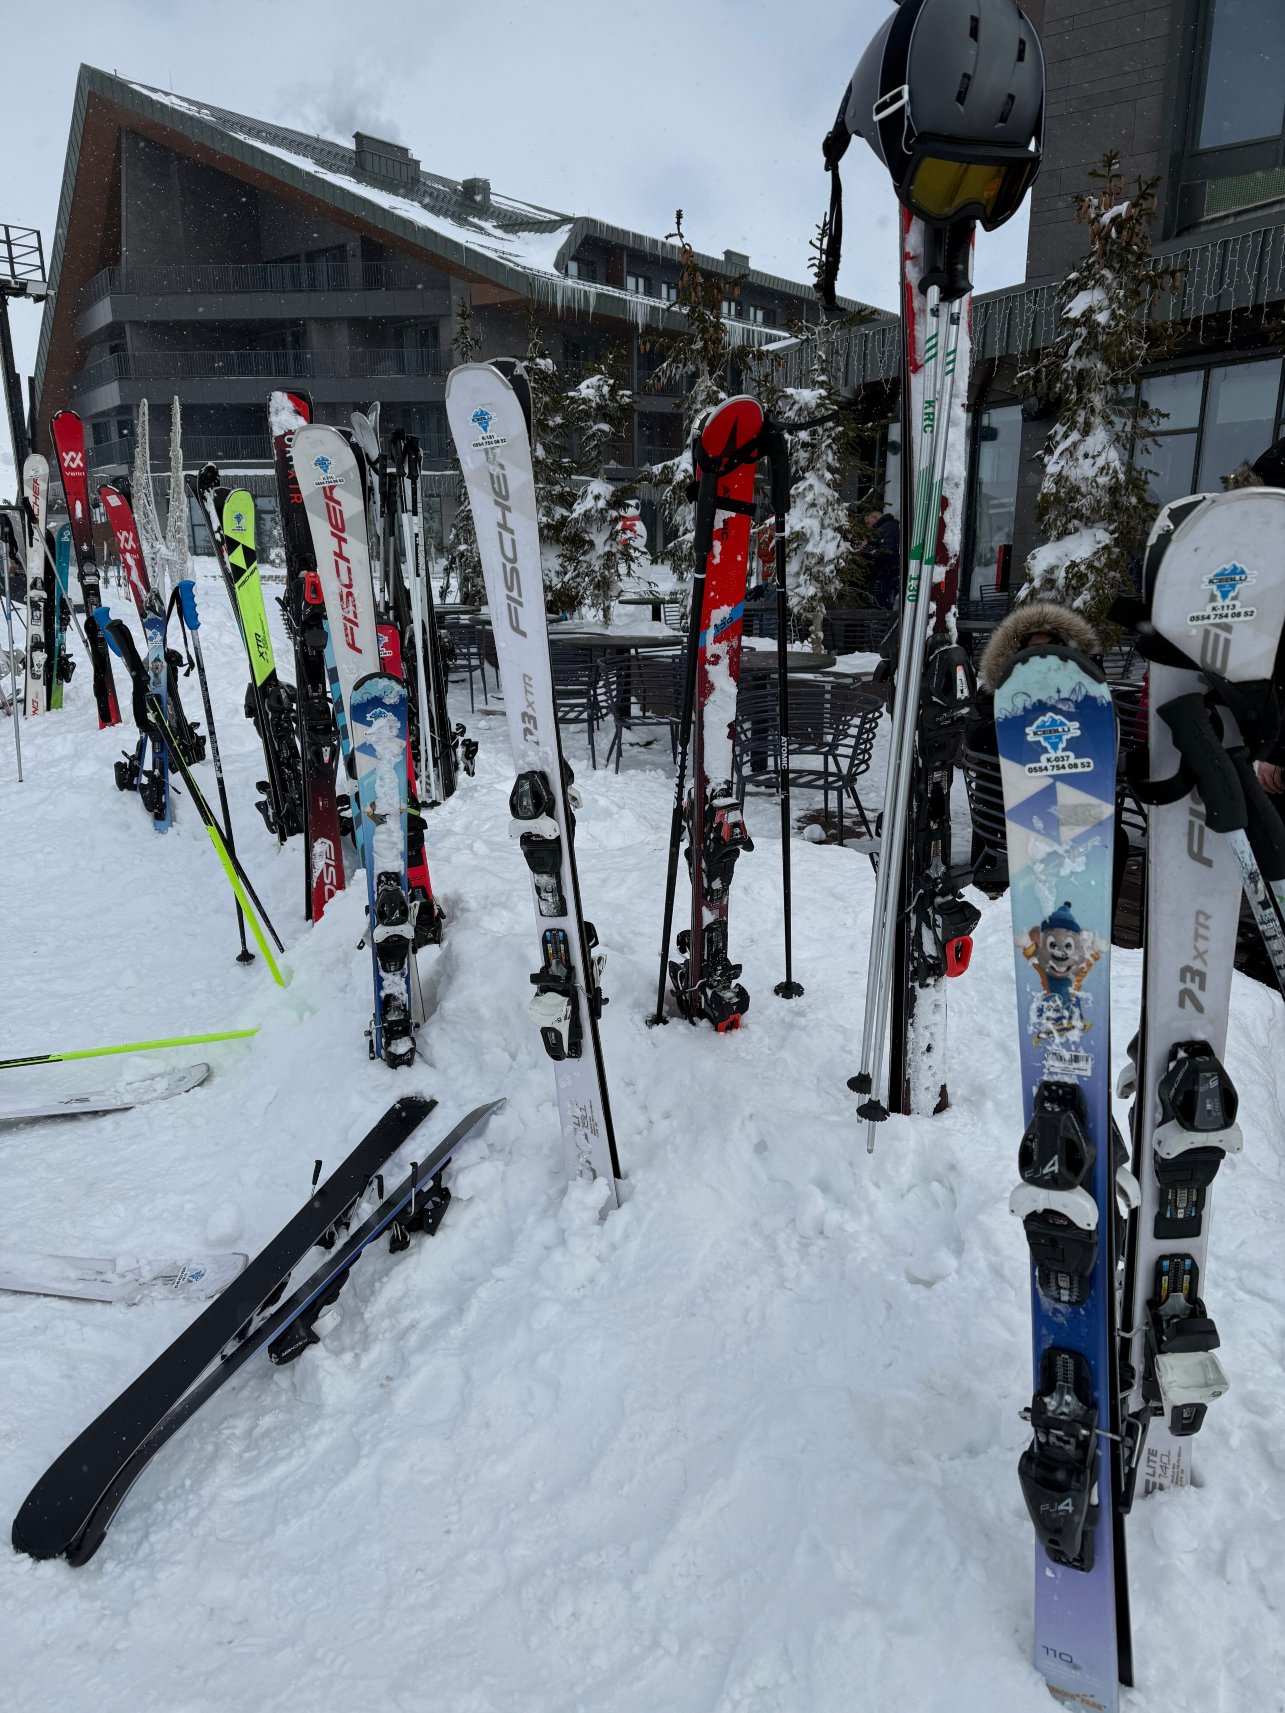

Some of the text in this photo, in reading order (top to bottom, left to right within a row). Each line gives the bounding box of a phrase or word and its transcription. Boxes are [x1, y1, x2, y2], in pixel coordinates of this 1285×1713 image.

[922, 399, 936, 434] KRC
[238, 566, 258, 591] FISCHER
[907, 573, 920, 604] 130
[1208, 575, 1248, 586] ICEBLU
[1190, 614, 1211, 622] 0554
[1212, 612, 1229, 620] 754
[1230, 611, 1242, 619] 08
[1211, 603, 1236, 612] K-113
[254, 632, 266, 661] XTR
[522, 672, 537, 714] XTR
[1032, 727, 1071, 736] ICEBLU
[1028, 765, 1049, 774] 0554
[1050, 764, 1066, 772] 754
[1046, 755, 1070, 764] K-037
[1178, 909, 1213, 1015] 73 XTR
[1024, 1154, 1060, 1180] FJ4
[1146, 1448, 1158, 1478] LITE
[1158, 1453, 1171, 1479] 140
[1040, 1498, 1074, 1514] FJ4
[1042, 1646, 1074, 1664] 110
